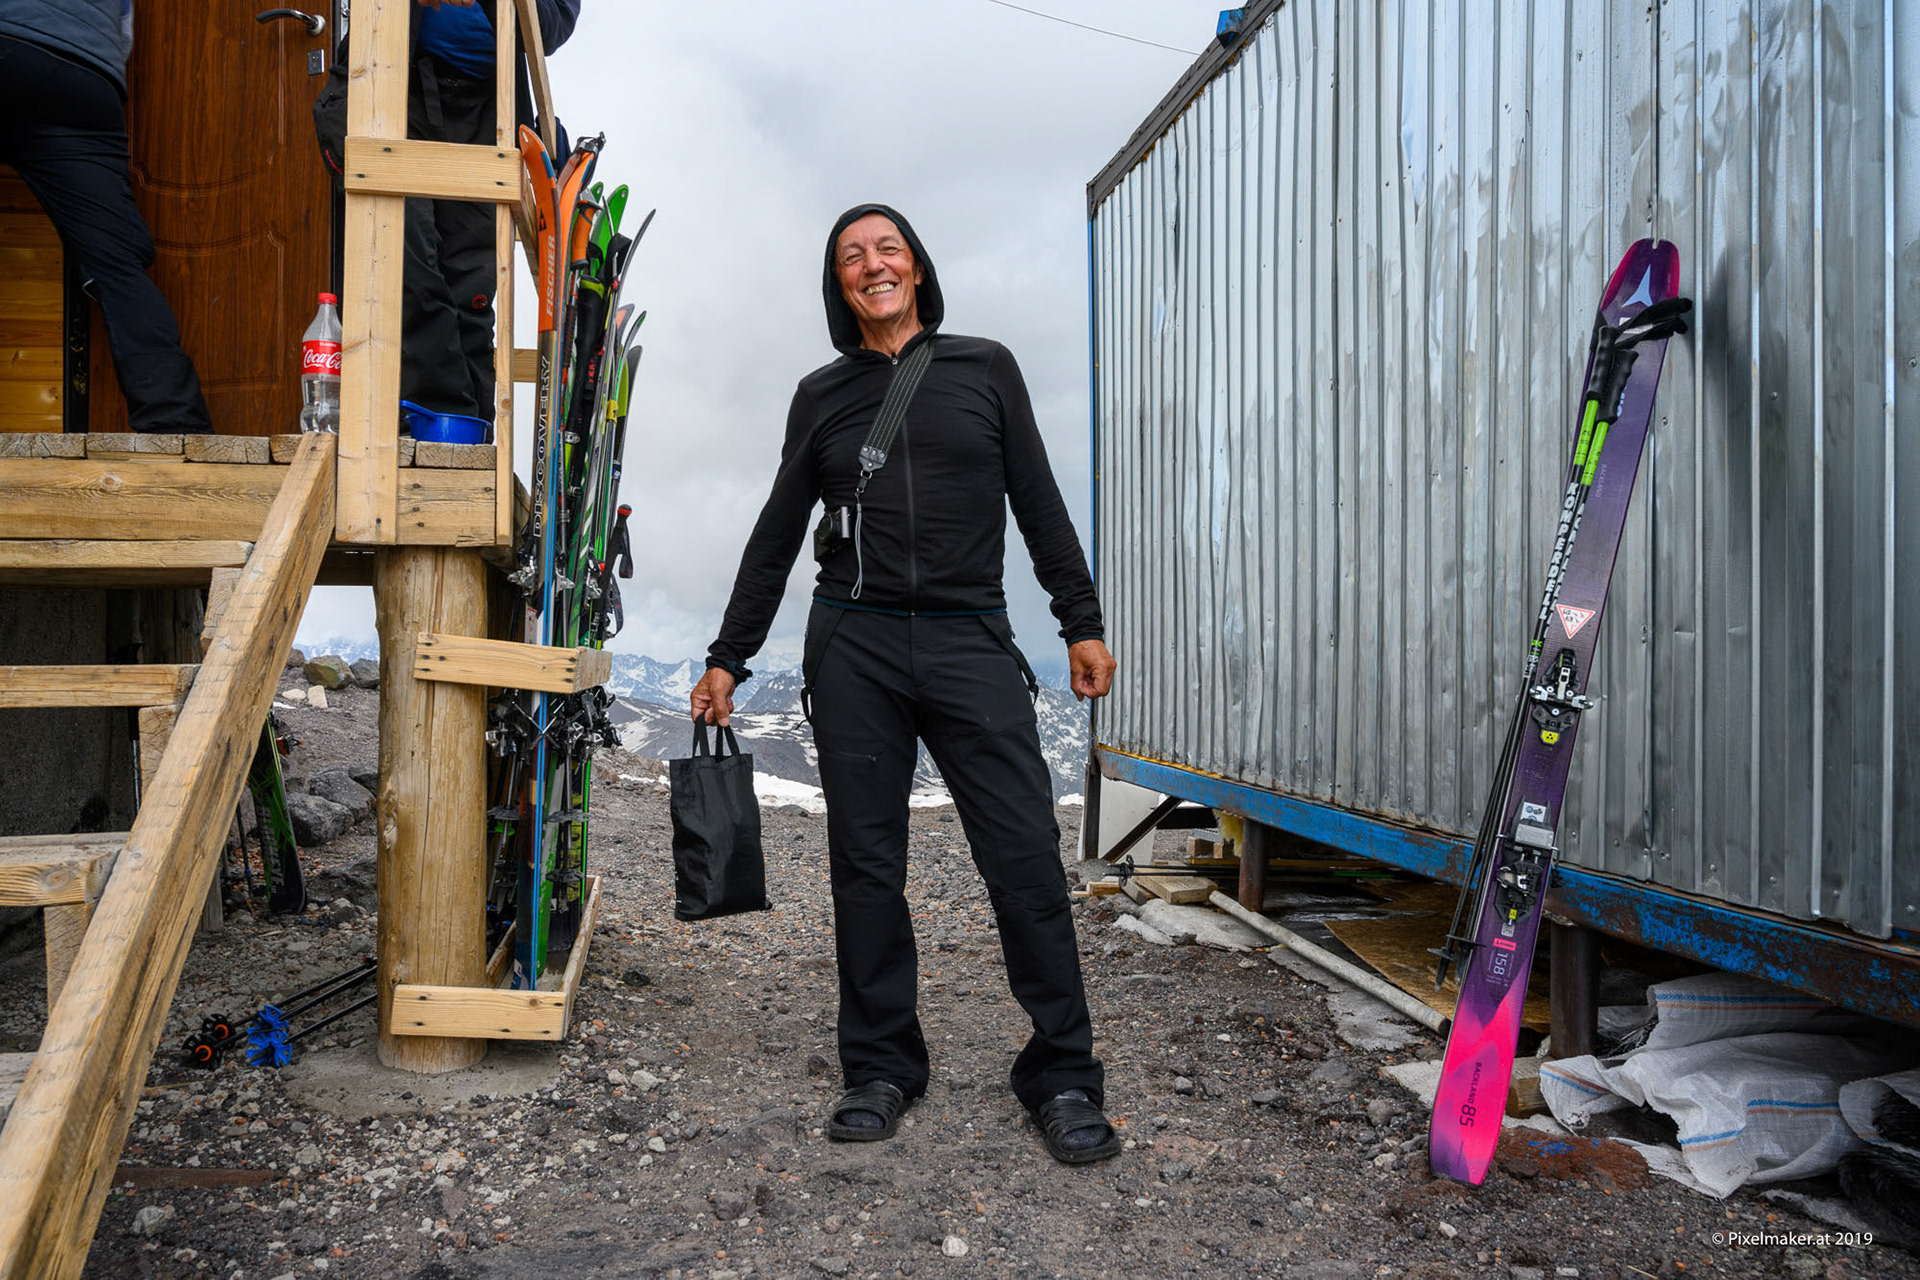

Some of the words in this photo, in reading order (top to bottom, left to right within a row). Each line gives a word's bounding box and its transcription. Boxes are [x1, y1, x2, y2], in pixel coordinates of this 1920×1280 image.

[546, 234, 555, 317] FISCHER
[303, 349, 342, 369] Coca-Co
[533, 355, 550, 538] DISCOVERY
[1538, 482, 1579, 620] KOMPERDELL
[1493, 952, 1509, 976] 158
[1468, 1062, 1482, 1104] BACKLAND
[1459, 1104, 1477, 1128] 85
